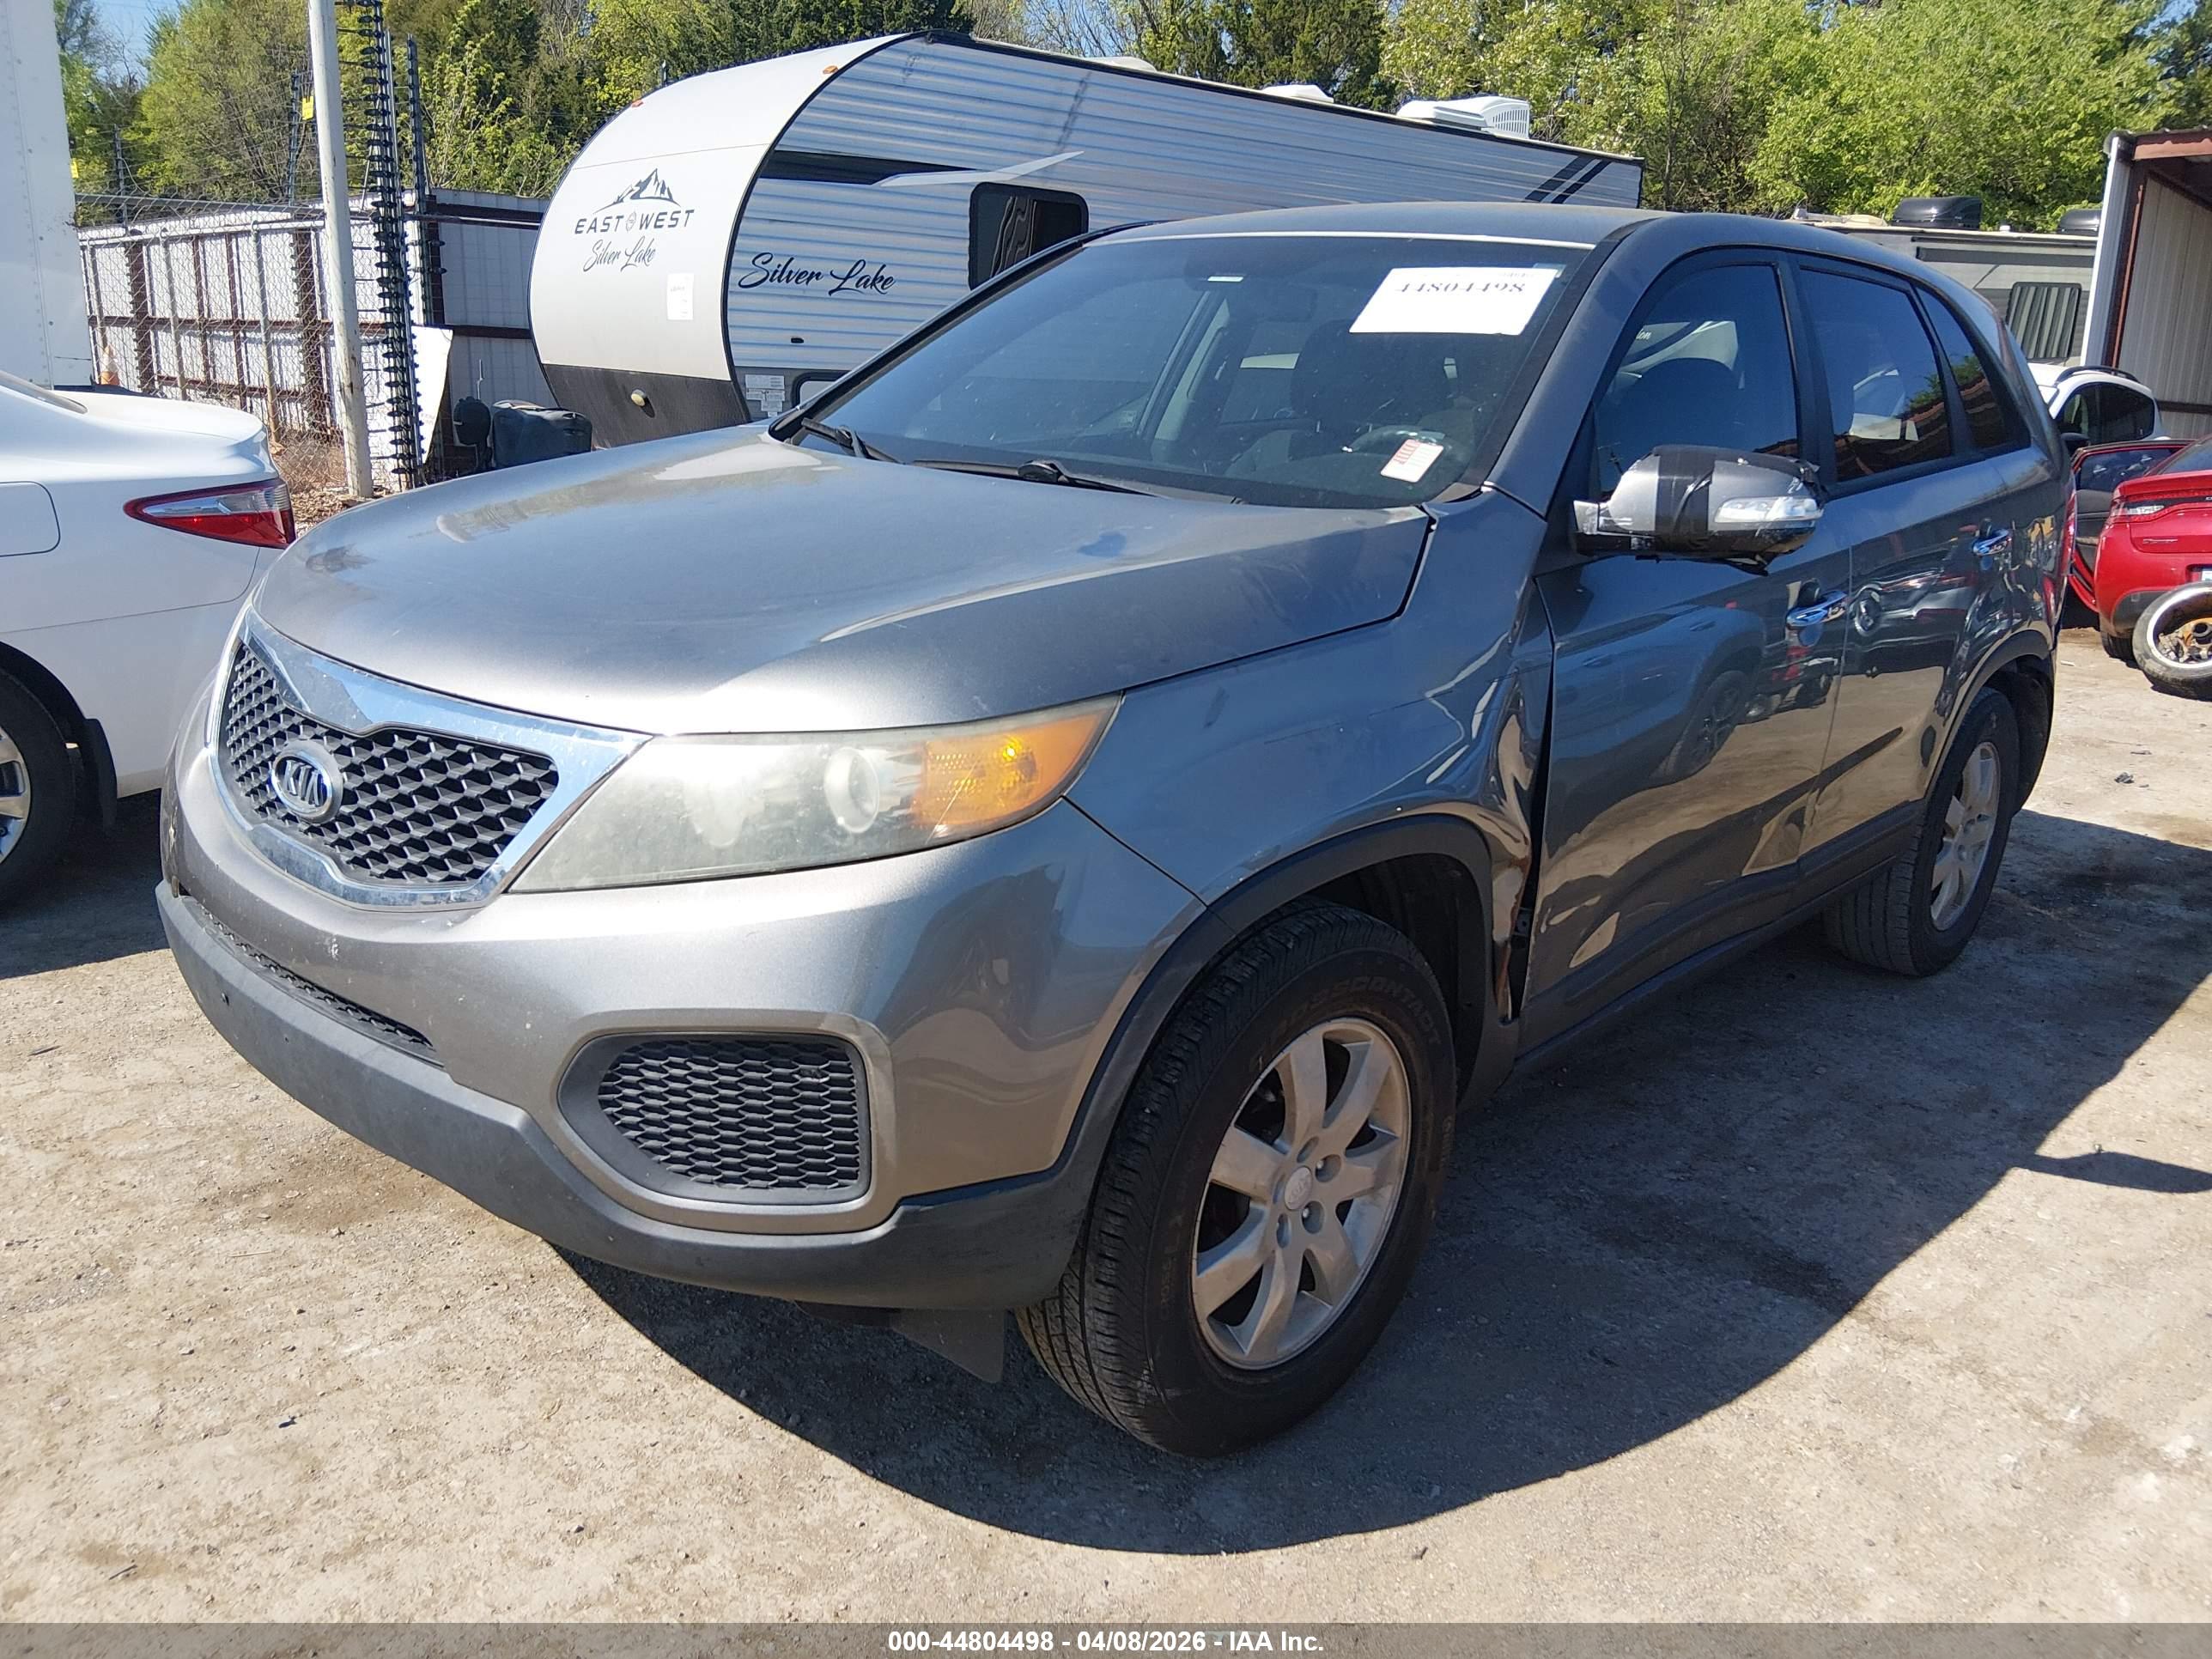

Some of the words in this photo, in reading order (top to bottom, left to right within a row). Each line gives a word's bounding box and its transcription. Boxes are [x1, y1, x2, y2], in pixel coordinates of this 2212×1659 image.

[574, 215, 624, 234] EAST
[639, 209, 695, 230] WEST
[582, 239, 622, 272] Silver
[620, 235, 656, 272] Lake
[738, 252, 824, 289] Silver
[828, 258, 896, 296] Lake
